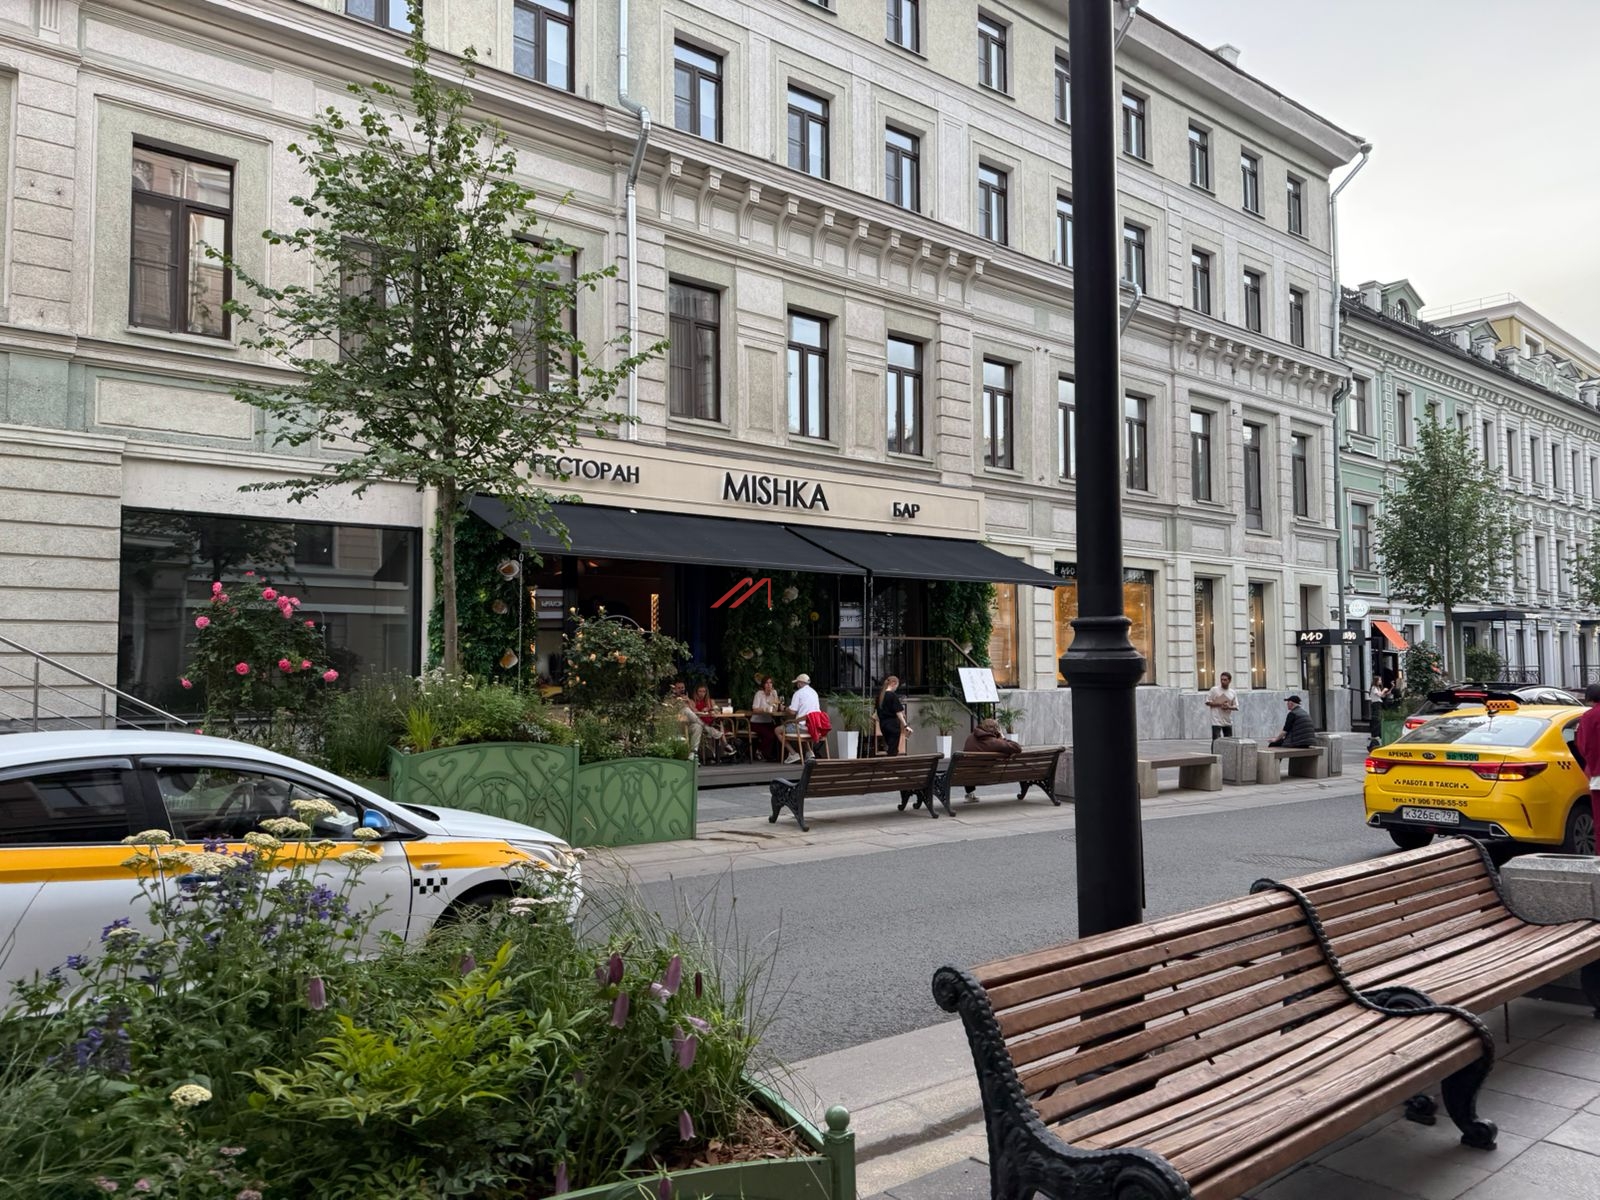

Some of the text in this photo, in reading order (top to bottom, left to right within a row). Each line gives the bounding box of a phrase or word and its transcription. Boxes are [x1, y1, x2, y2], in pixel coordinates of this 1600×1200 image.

[722, 471, 830, 512] MISHKA
[892, 502, 920, 518] БАР
[1388, 751, 1413, 759] АРЕНДА
[1402, 779, 1427, 787] РАБОТА
[1436, 781, 1459, 789] ТАКСИ
